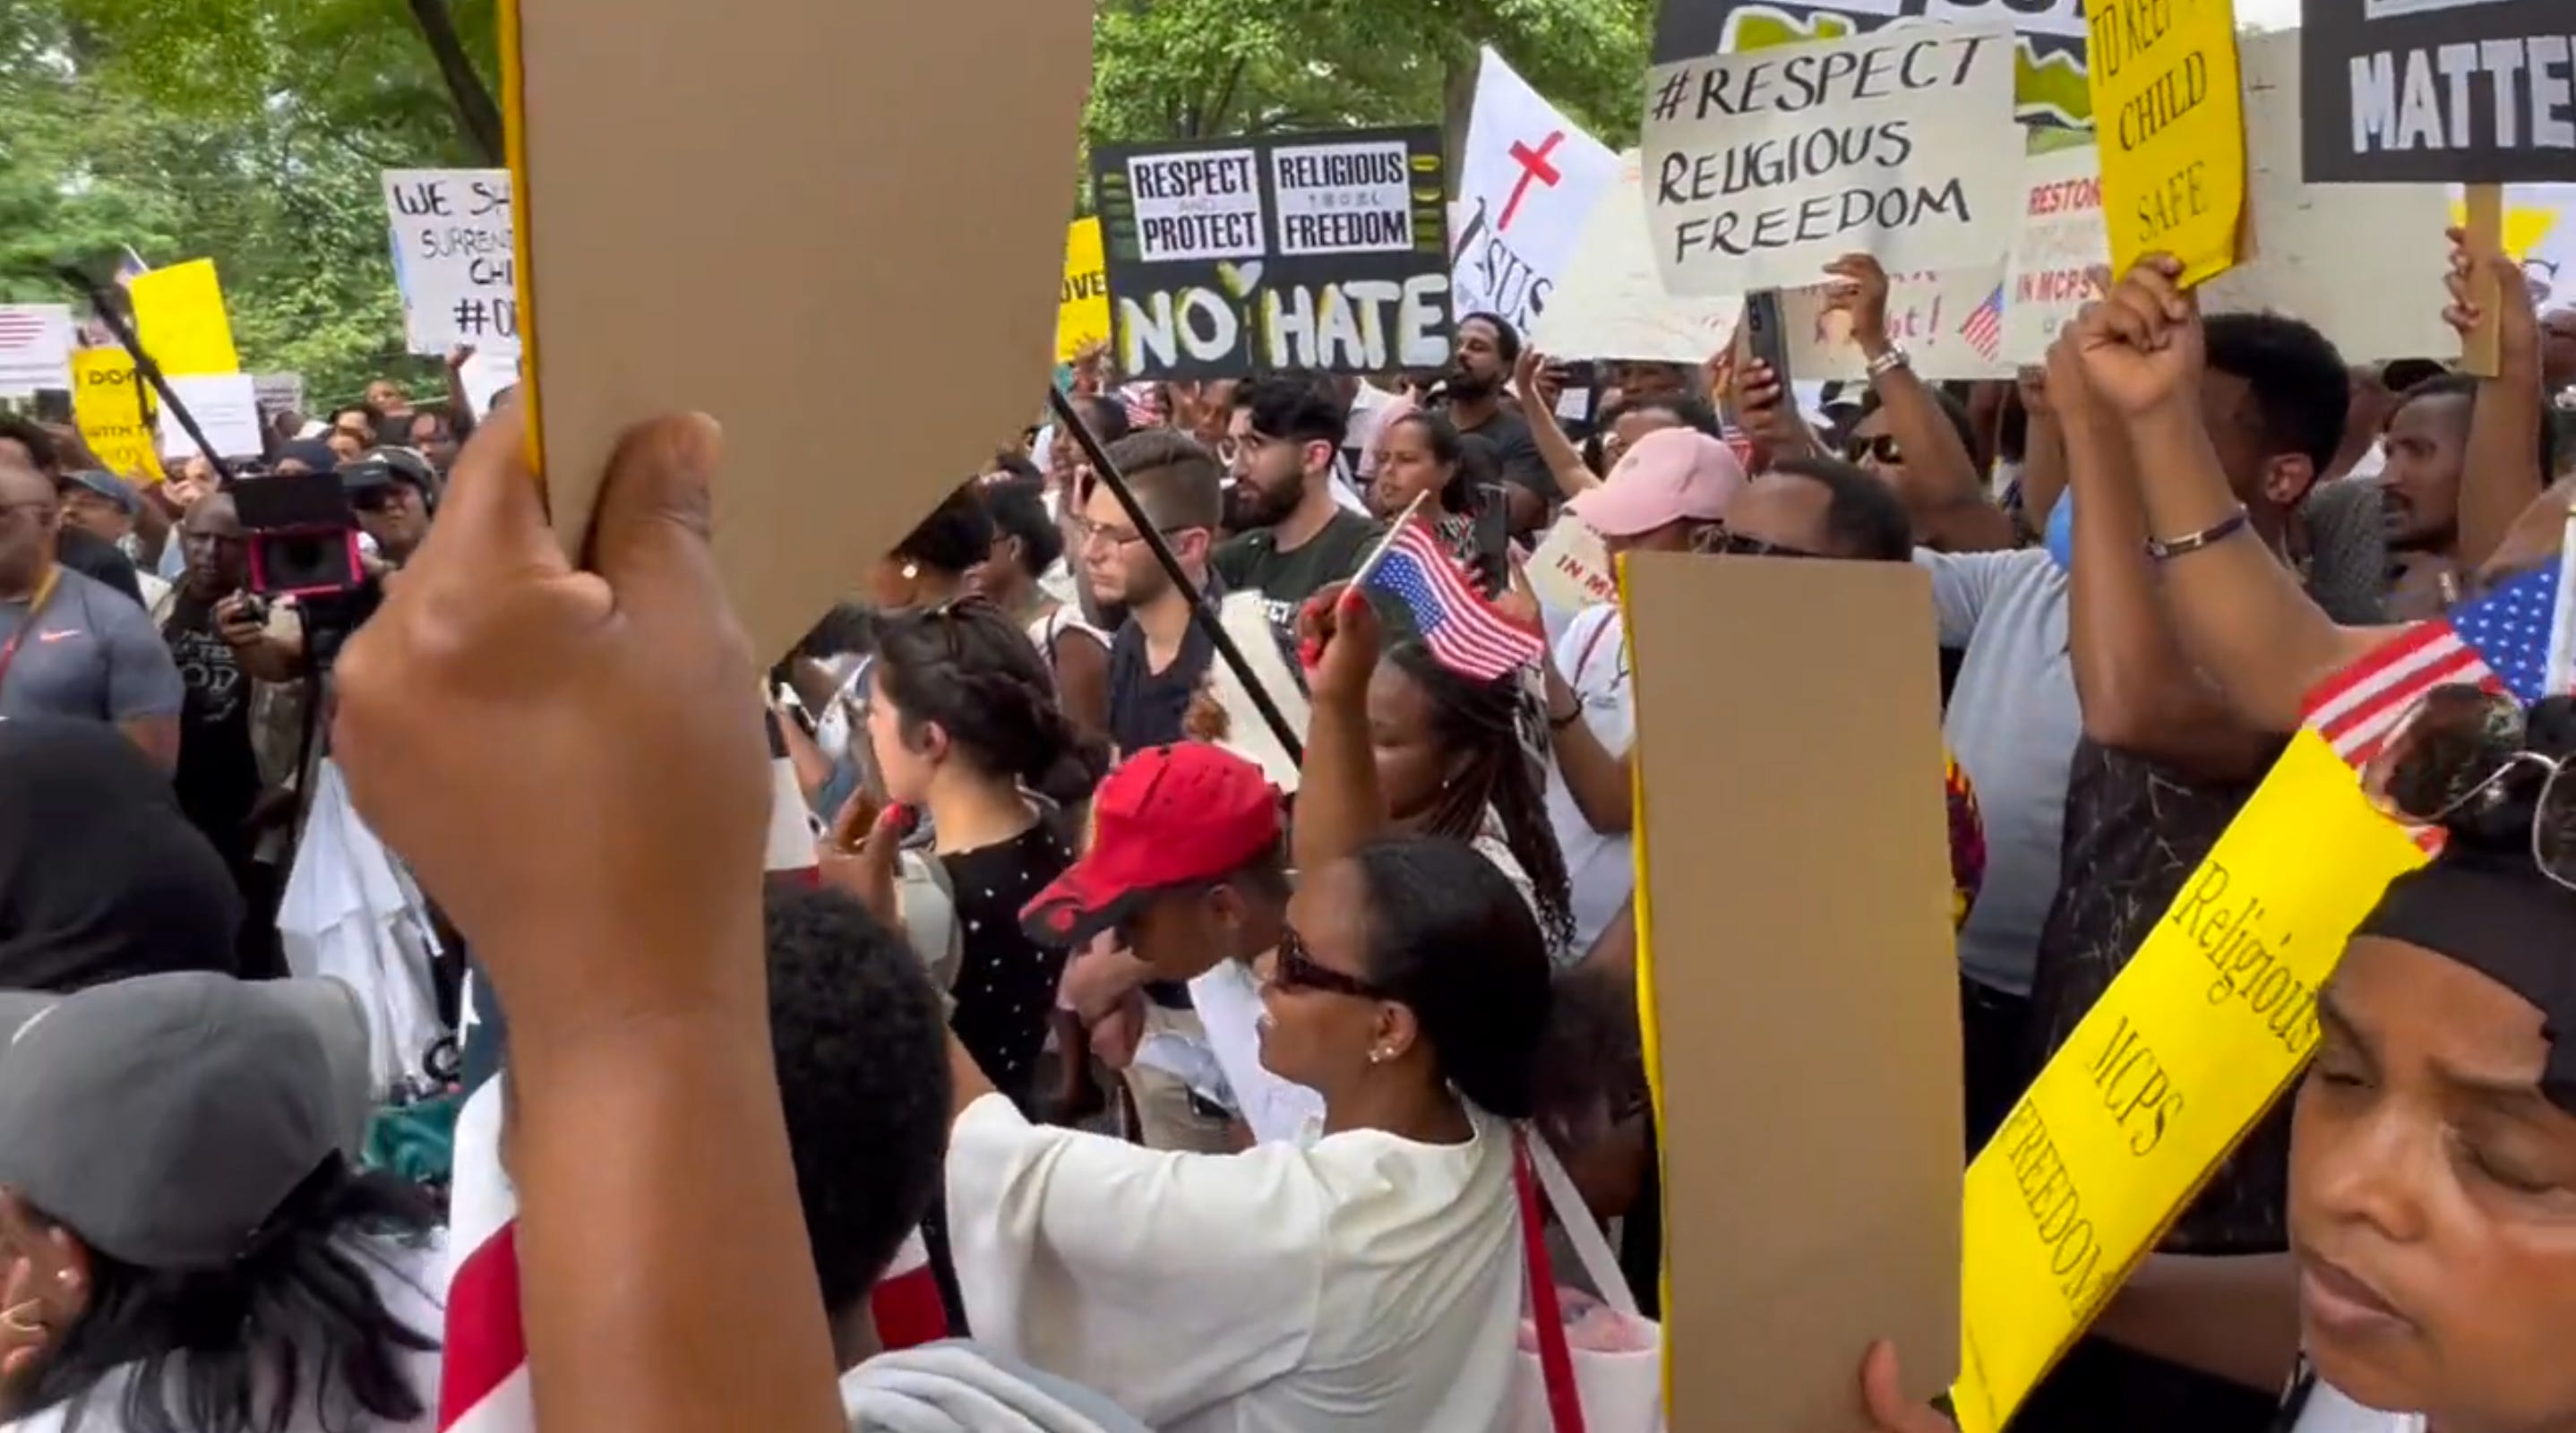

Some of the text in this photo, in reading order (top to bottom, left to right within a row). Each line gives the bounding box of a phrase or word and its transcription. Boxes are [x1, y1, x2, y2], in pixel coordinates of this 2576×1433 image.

[1652, 34, 2000, 121] #RESPECT
[2092, 4, 2120, 87] TO
[2118, 50, 2207, 151] CHILD
[2349, 35, 2576, 154] MATTE
[392, 181, 453, 216] WE
[1134, 156, 1251, 199] RESPECT
[1277, 151, 1404, 189] RELIGIOUS
[1658, 120, 1912, 206] RELIGIOUS
[2138, 159, 2207, 243] SAFE
[1142, 211, 1258, 253] PROTECT
[1284, 210, 1409, 250] FREEDOM
[1676, 177, 1971, 263] FREEDOM
[1120, 274, 1449, 376] NO HATE
[1555, 553, 1584, 580] IN
[2172, 859, 2320, 1054] Religious
[2086, 1015, 2184, 1157] MCPS
